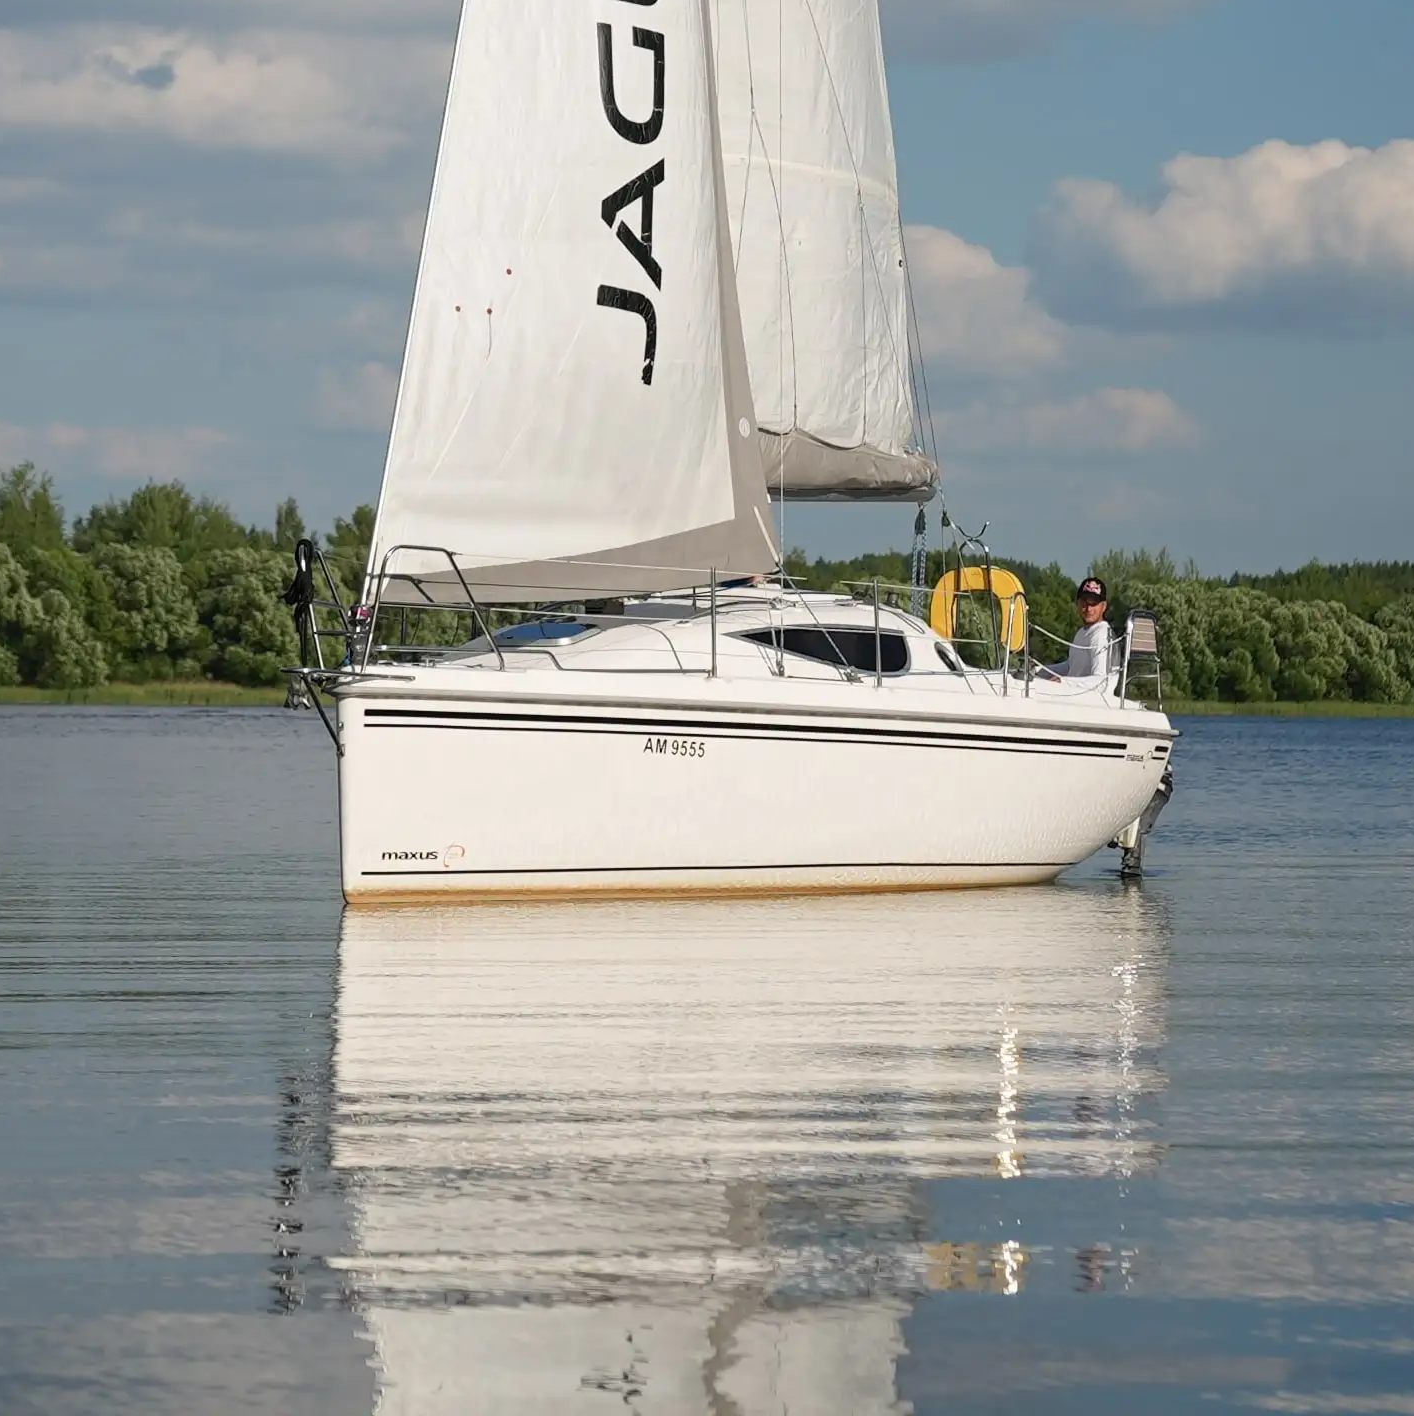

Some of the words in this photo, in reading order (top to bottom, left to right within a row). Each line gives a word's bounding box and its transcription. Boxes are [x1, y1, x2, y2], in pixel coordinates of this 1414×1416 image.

[643, 737, 668, 754] AM
[671, 739, 706, 758] 9555
[381, 850, 439, 861] maxus
